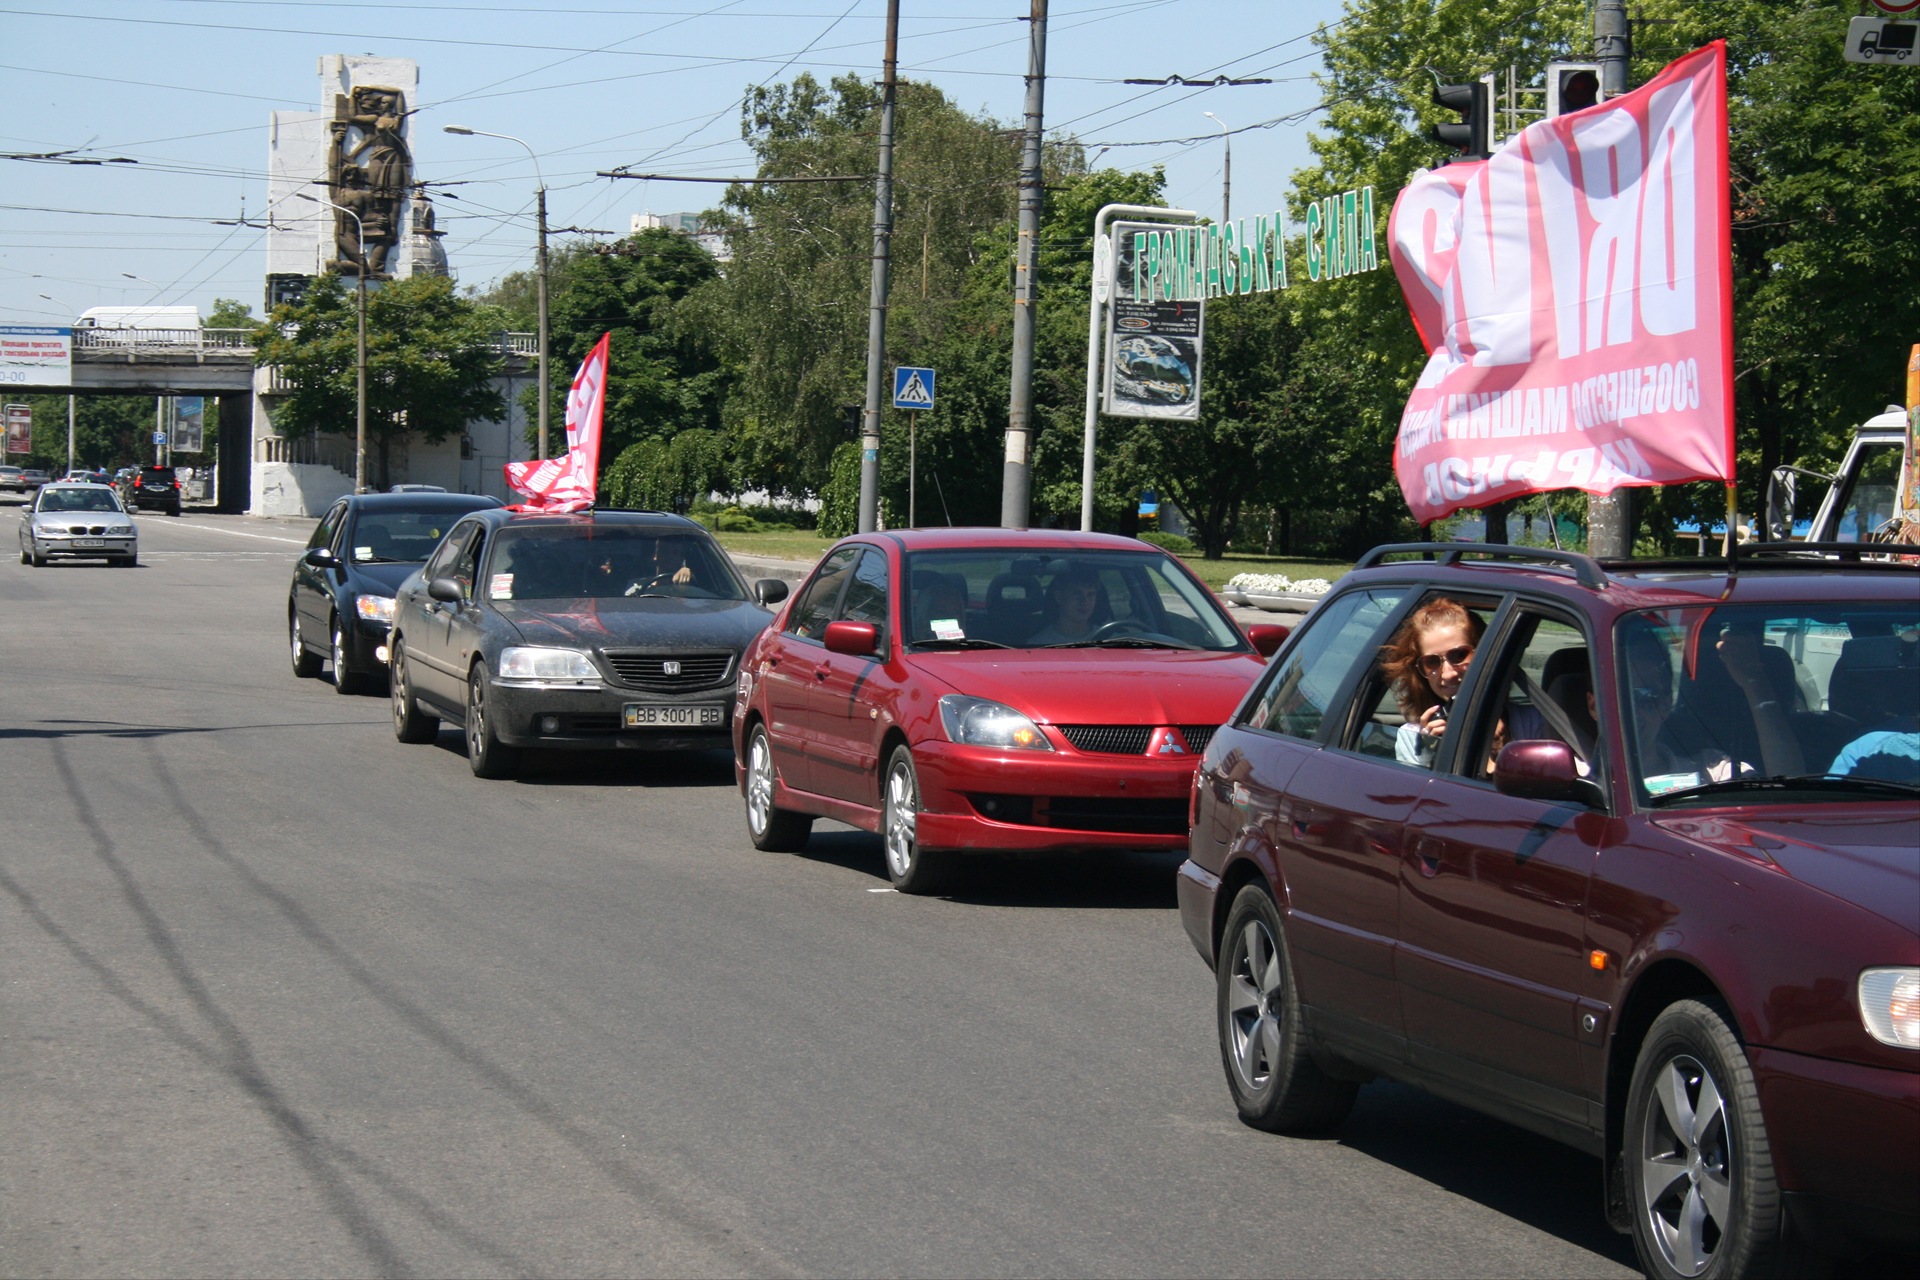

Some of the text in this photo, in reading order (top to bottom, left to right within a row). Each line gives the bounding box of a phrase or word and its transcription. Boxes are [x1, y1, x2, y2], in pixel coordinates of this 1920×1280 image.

[1133, 186, 1377, 302] ГРОМАДСЬКА СИЛА
[636, 708, 719, 723] BB 3001 BB
